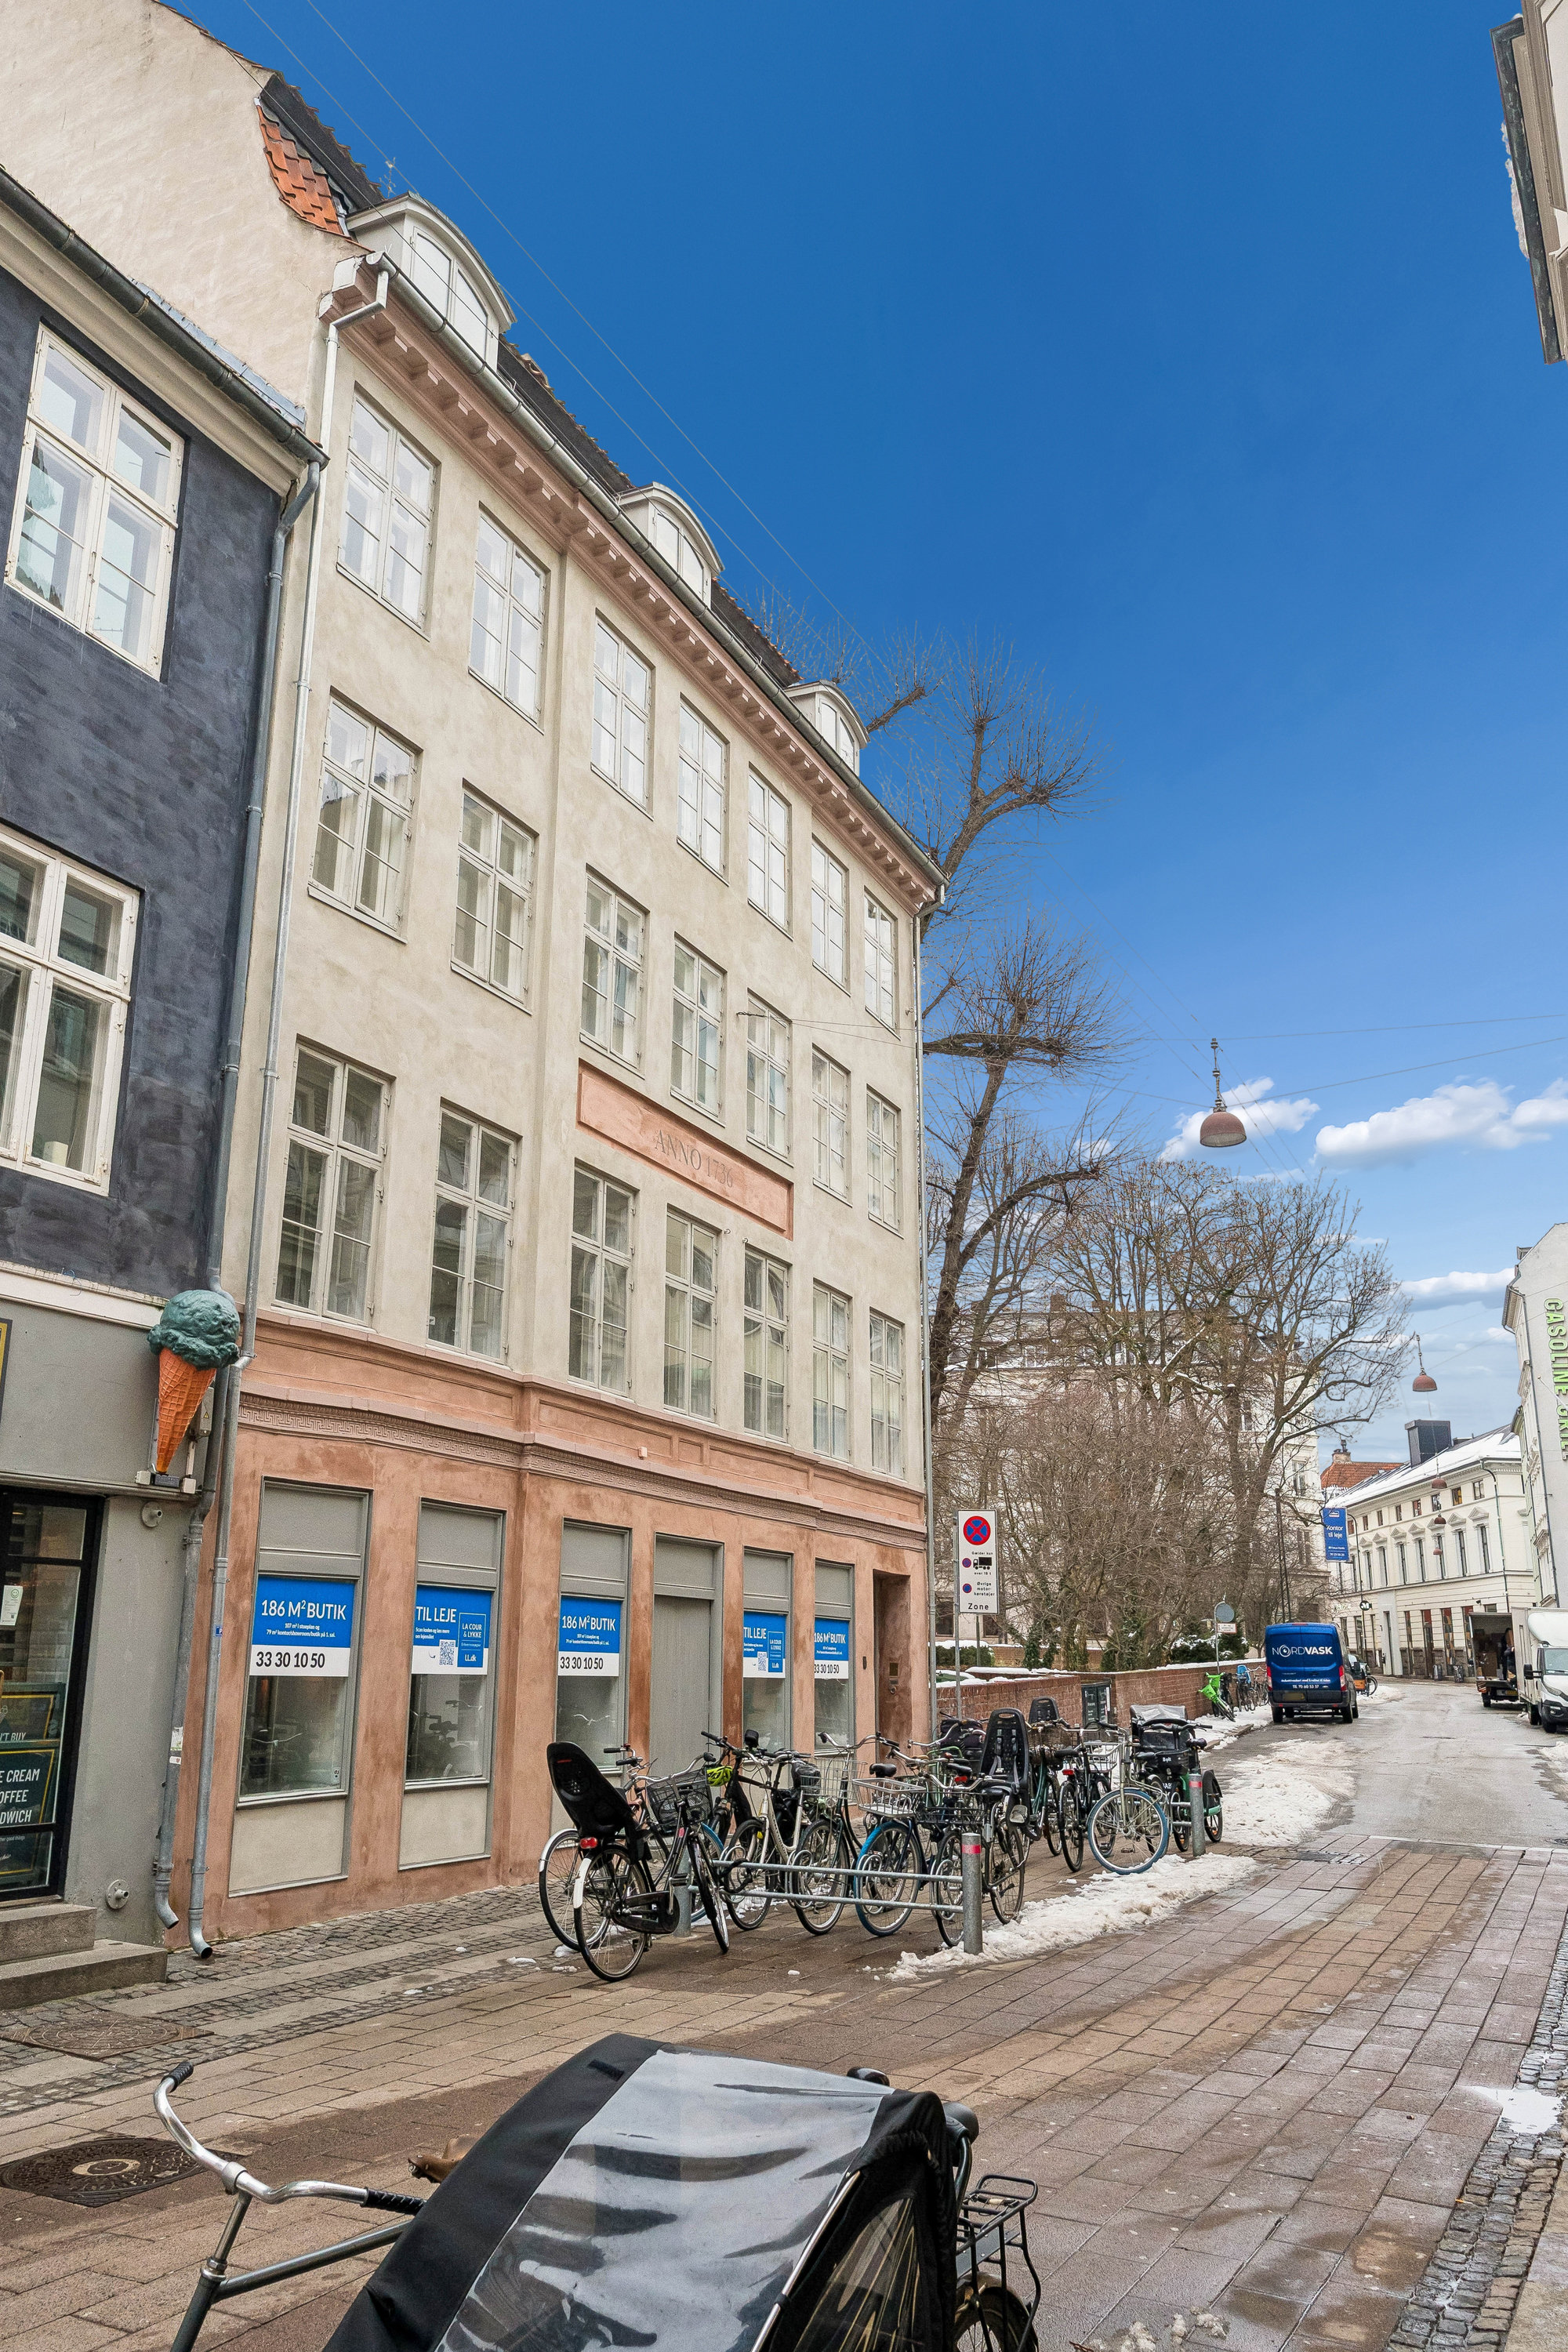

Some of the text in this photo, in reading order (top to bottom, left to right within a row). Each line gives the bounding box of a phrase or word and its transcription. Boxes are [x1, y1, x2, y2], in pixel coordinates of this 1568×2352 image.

[654, 1129, 733, 1188] ANNO 1736
[1544, 1298, 1568, 1396] GASOLINE
[261, 1599, 285, 1617] 186
[307, 1602, 347, 1620] BUTIK
[416, 1606, 457, 1623] TIL LEJE
[562, 1615, 577, 1629] 186
[590, 1617, 616, 1632] BUTIK
[743, 1626, 767, 1639] TIL LEJE
[814, 1632, 823, 1643] 186
[830, 1633, 846, 1644] BUTIK
[1272, 1644, 1333, 1657] NORDVASK
[256, 1651, 325, 1668] 33 30 10 50
[560, 1656, 603, 1670] 33 30 10 50
[820, 1664, 827, 1674] 30
[833, 1664, 839, 1674] 50
[11, 1732, 26, 1741] BUY
[6, 1768, 40, 1782] CREAM
[0, 1809, 32, 1824] DWICH
